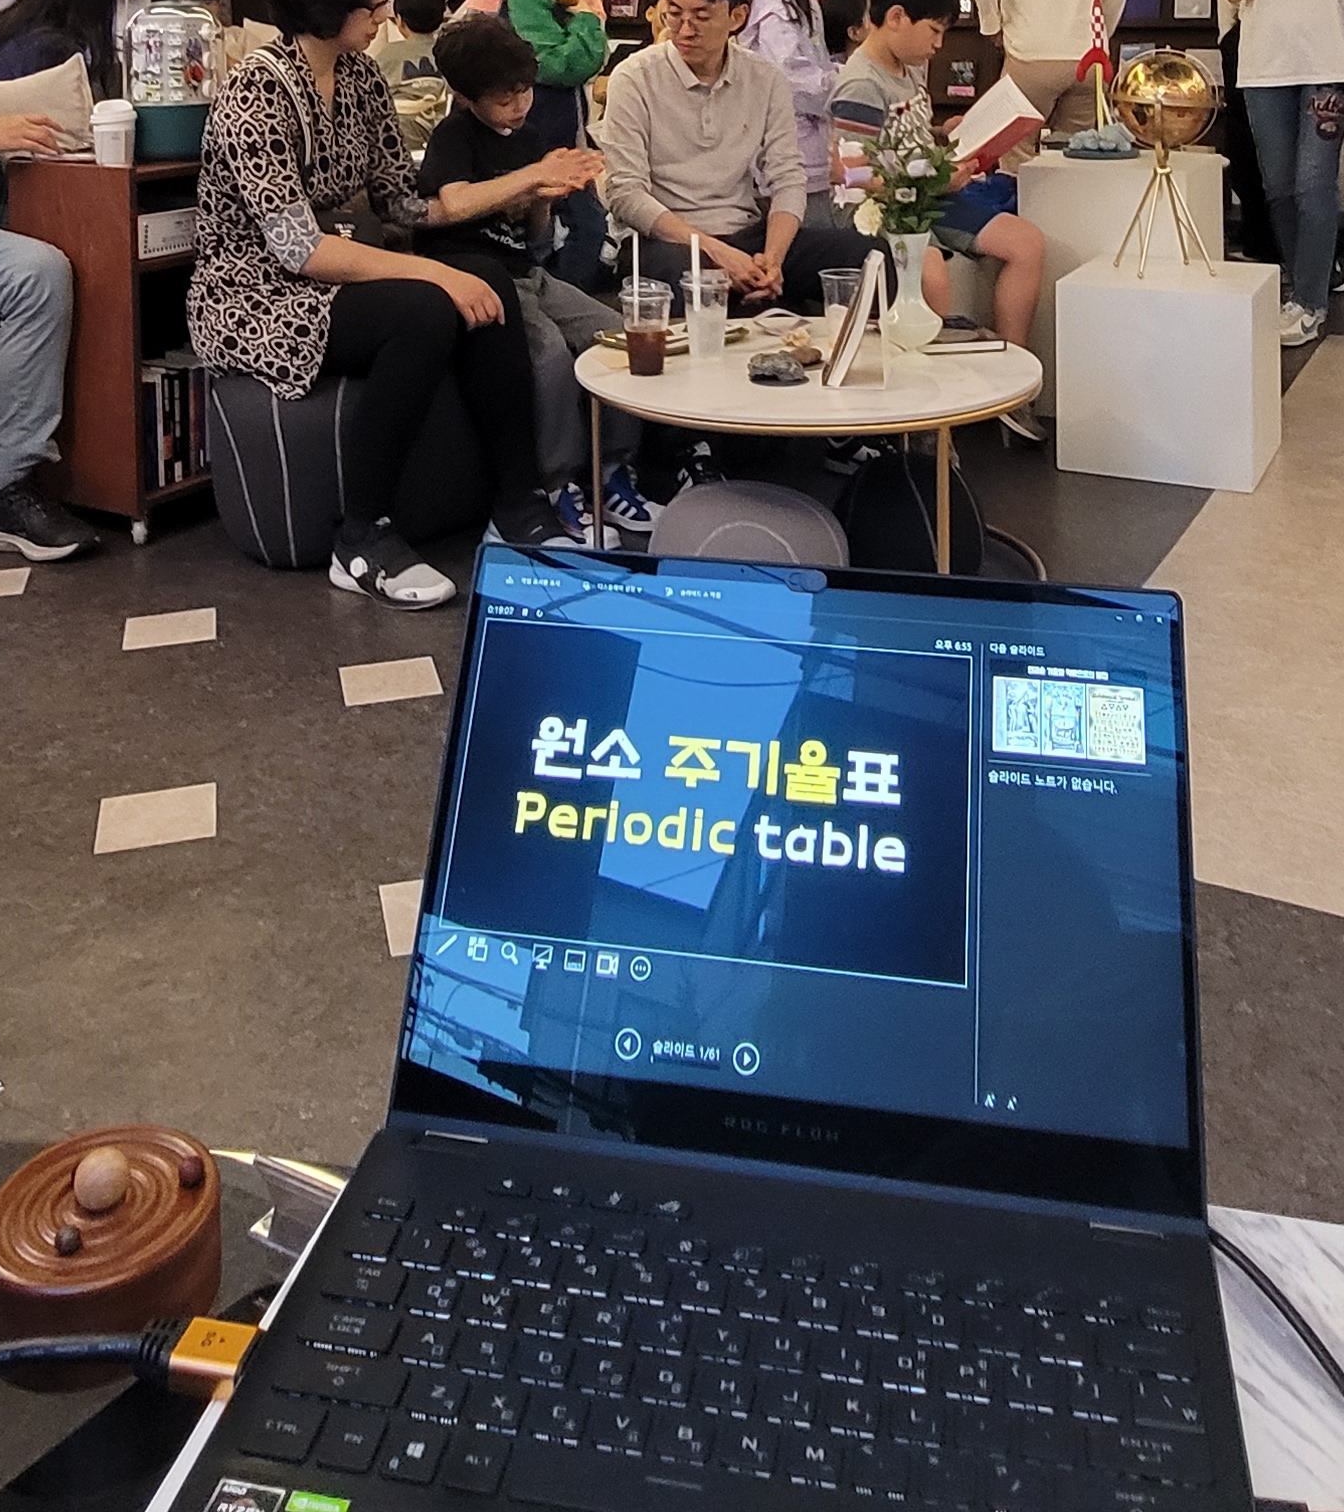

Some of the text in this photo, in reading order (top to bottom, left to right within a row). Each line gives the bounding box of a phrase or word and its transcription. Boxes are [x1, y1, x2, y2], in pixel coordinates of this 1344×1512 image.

[935, 639, 953, 651] 오후
[989, 642, 1045, 657] 다음 슬라이드
[531, 715, 902, 806] 원소 주기율표
[987, 769, 1119, 795] 슬라이드 노트가 없습니다.
[514, 790, 907, 874] Periodic table
[652, 1039, 721, 1062] 슬라이드 1/61
